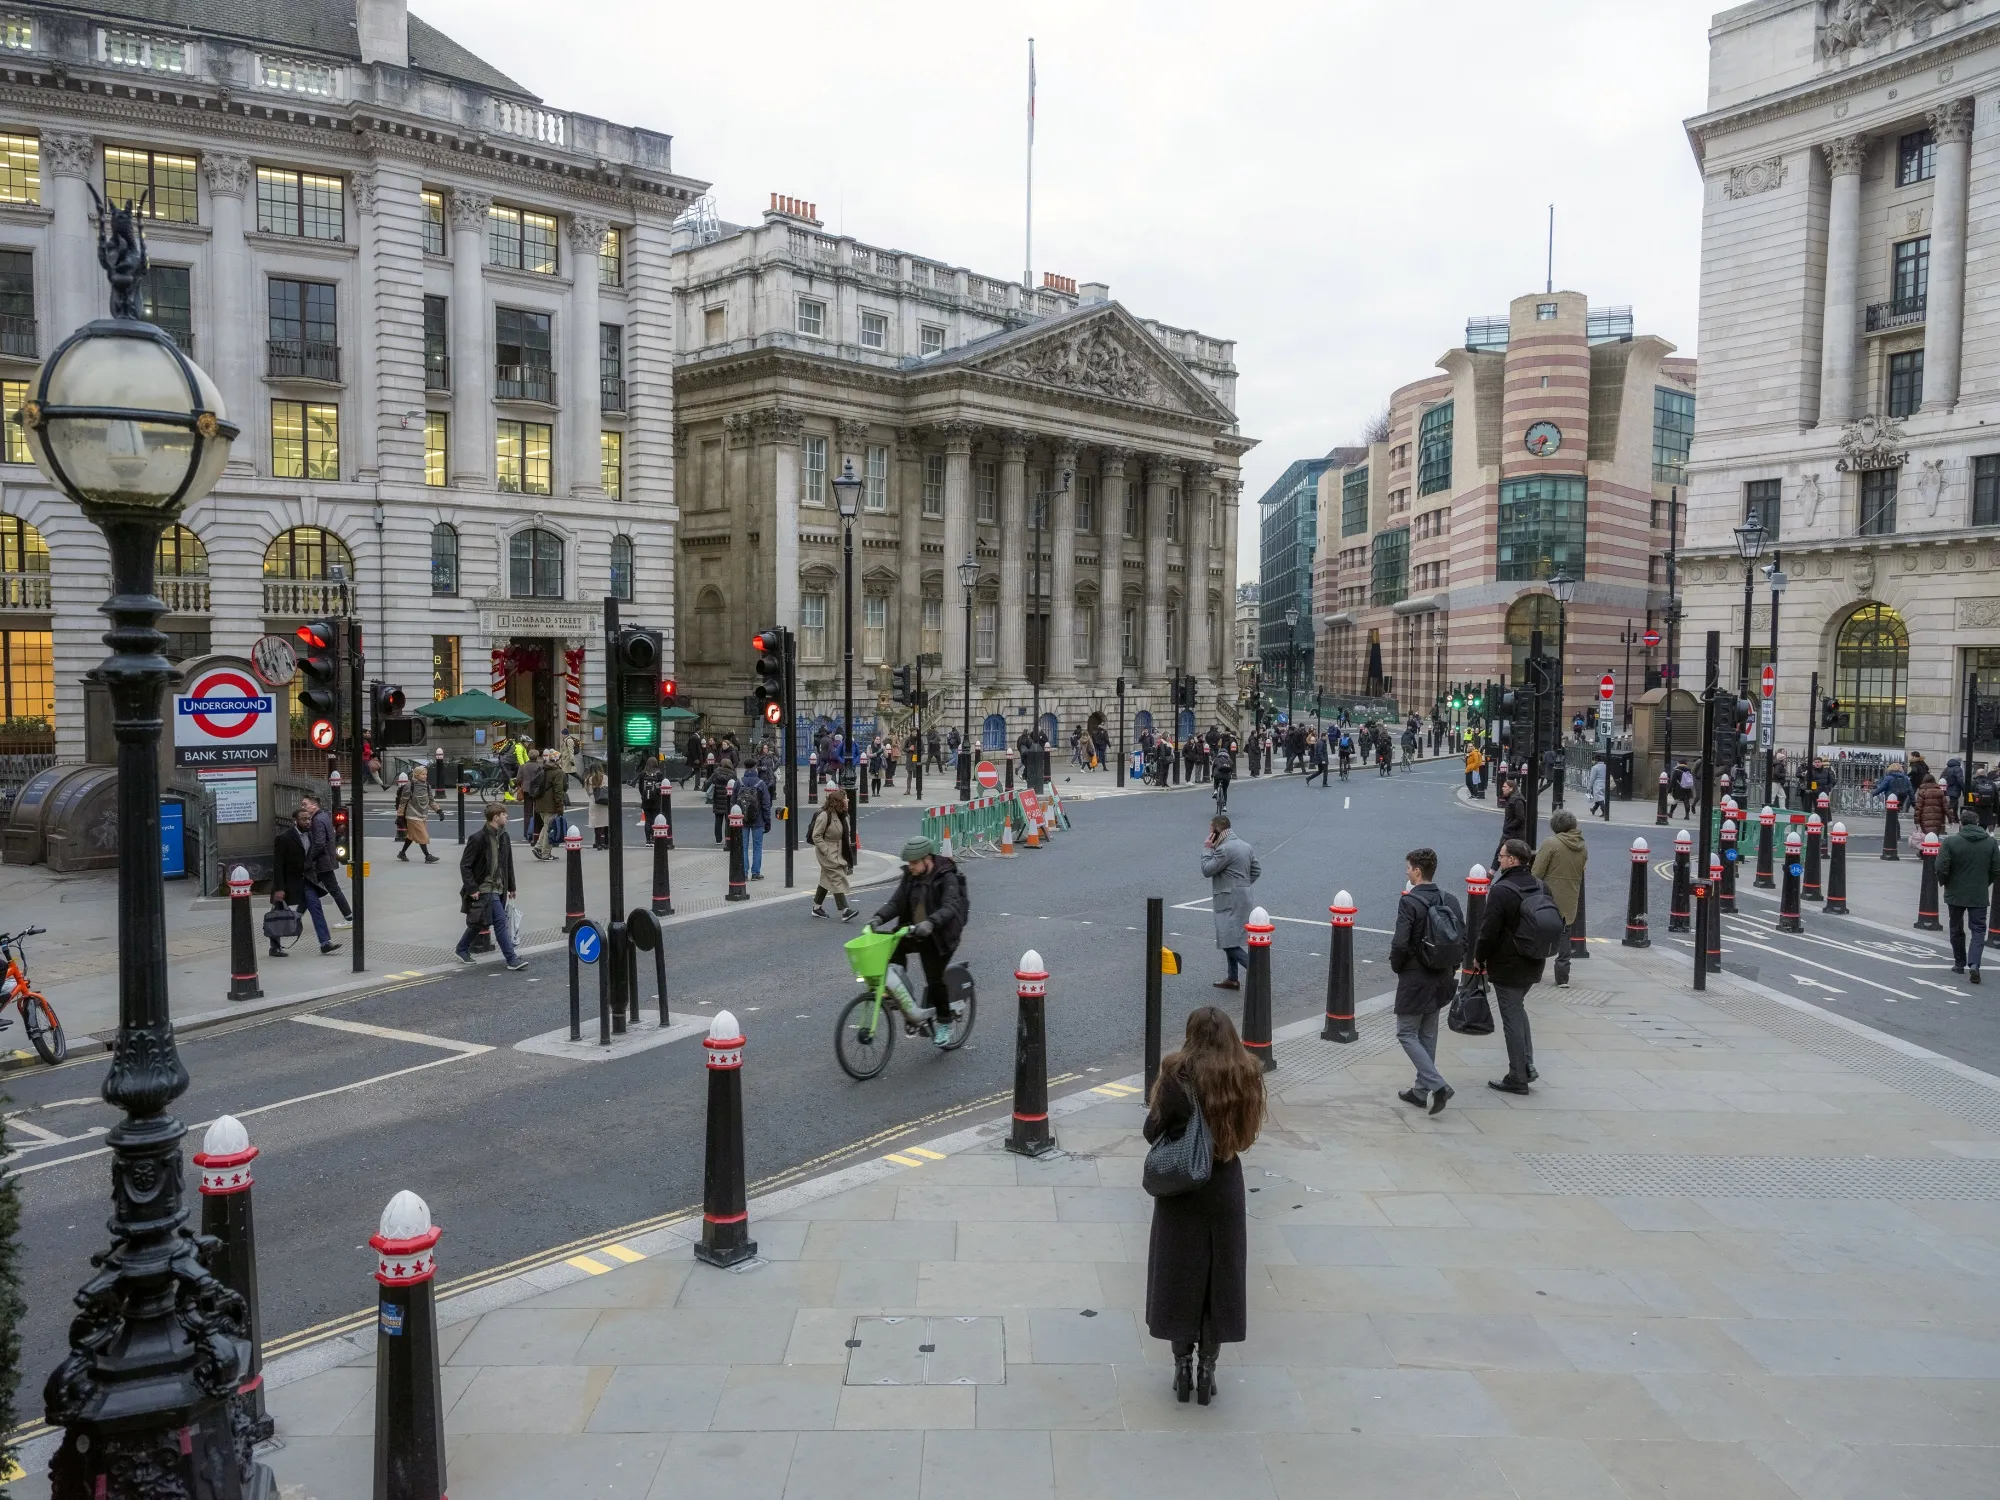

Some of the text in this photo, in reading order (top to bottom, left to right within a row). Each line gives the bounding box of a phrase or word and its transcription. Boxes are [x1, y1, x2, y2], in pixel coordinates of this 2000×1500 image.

[511, 615, 551, 624] LOMBARD
[554, 616, 582, 625] STREET
[183, 700, 267, 712] UNDERGROUND
[184, 749, 268, 761] BANK STATION
[1848, 751, 1882, 760] NatWest
